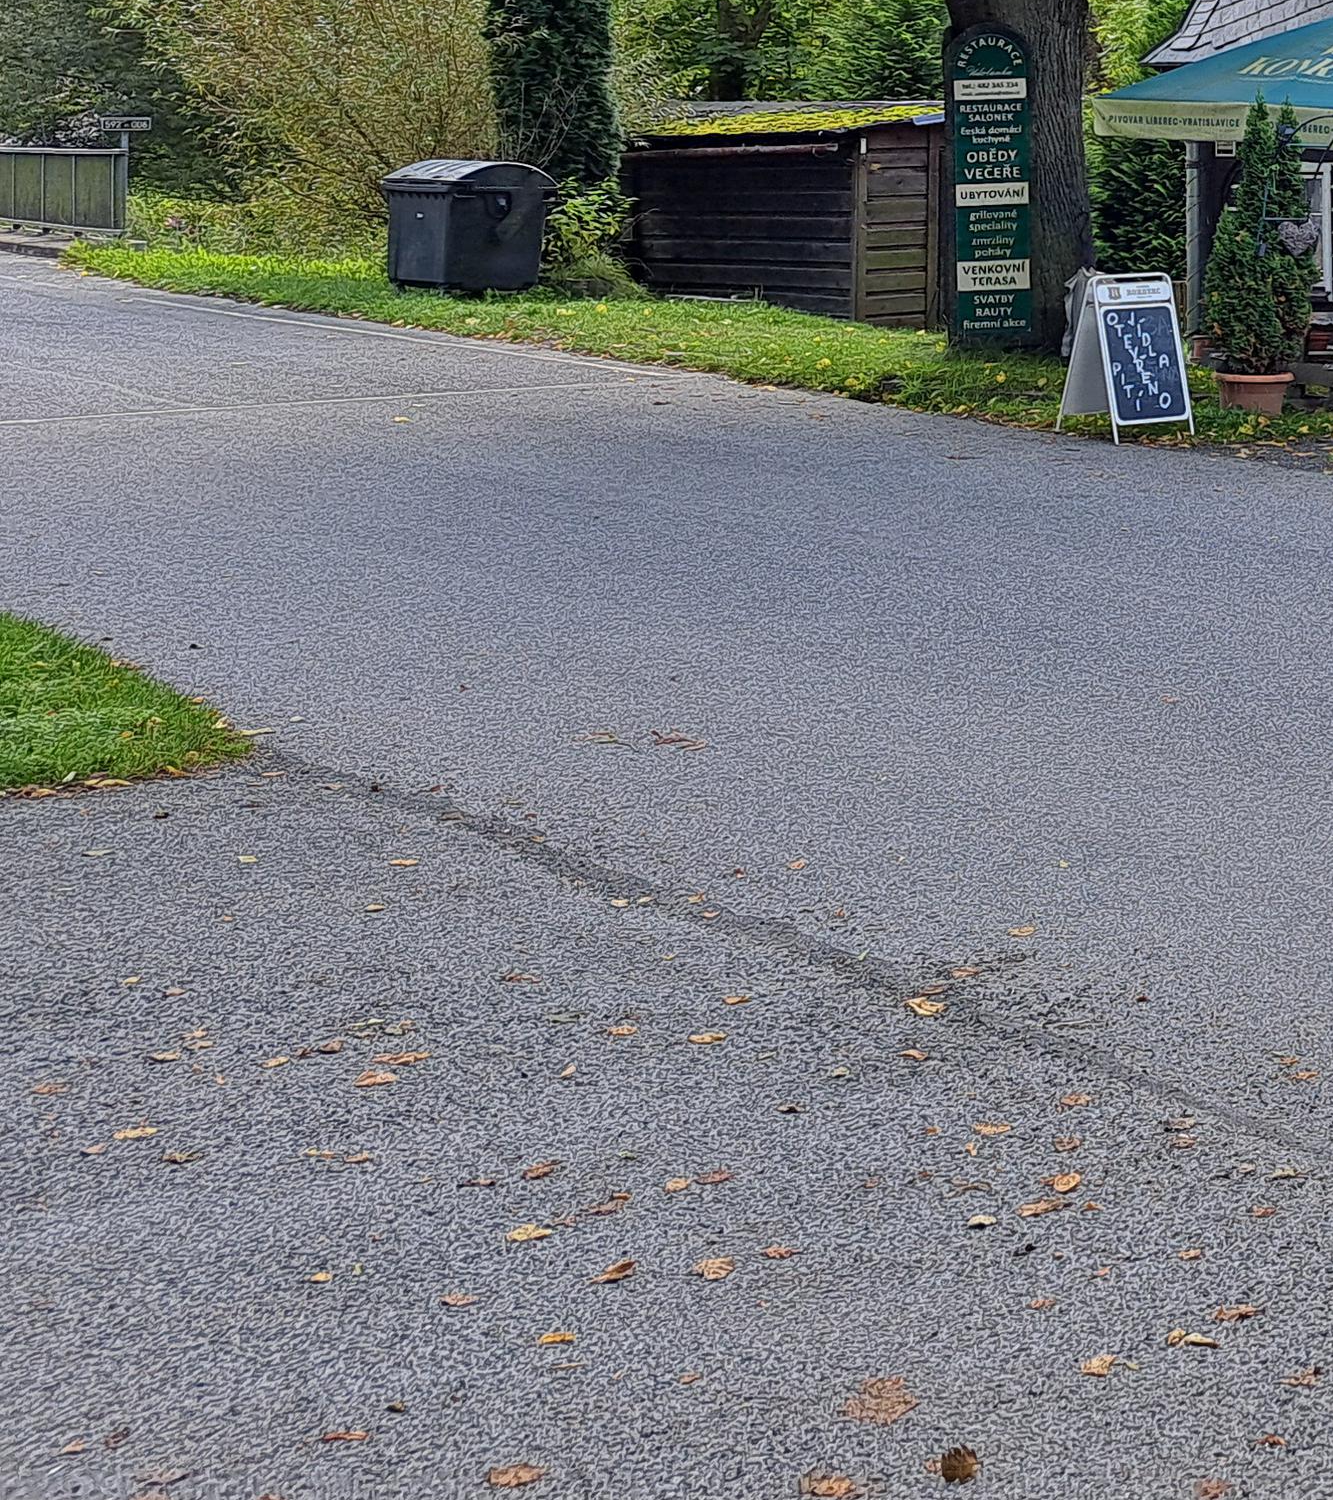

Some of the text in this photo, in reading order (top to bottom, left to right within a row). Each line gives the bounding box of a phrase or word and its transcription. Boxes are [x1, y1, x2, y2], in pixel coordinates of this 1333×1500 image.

[957, 37, 1022, 68] RESTAURACE
[960, 103, 1022, 113] RESTAURACE
[968, 113, 1014, 122] SALONEK
[1108, 115, 1143, 125] PIVOVAR
[966, 147, 1018, 163] OBĚDY
[964, 163, 1021, 180] VEČEŘE
[960, 186, 1024, 200] UBYTOVÁNÍ
[969, 209, 1018, 221] grilované
[968, 221, 1018, 233] speciality
[974, 247, 1012, 259] poháry
[962, 261, 1026, 275] VENKOVNÍ
[970, 275, 1017, 287] TERASA
[973, 294, 1015, 305] SVATBY
[975, 306, 1013, 317] RAUTY
[963, 318, 1027, 331] firemní akce
